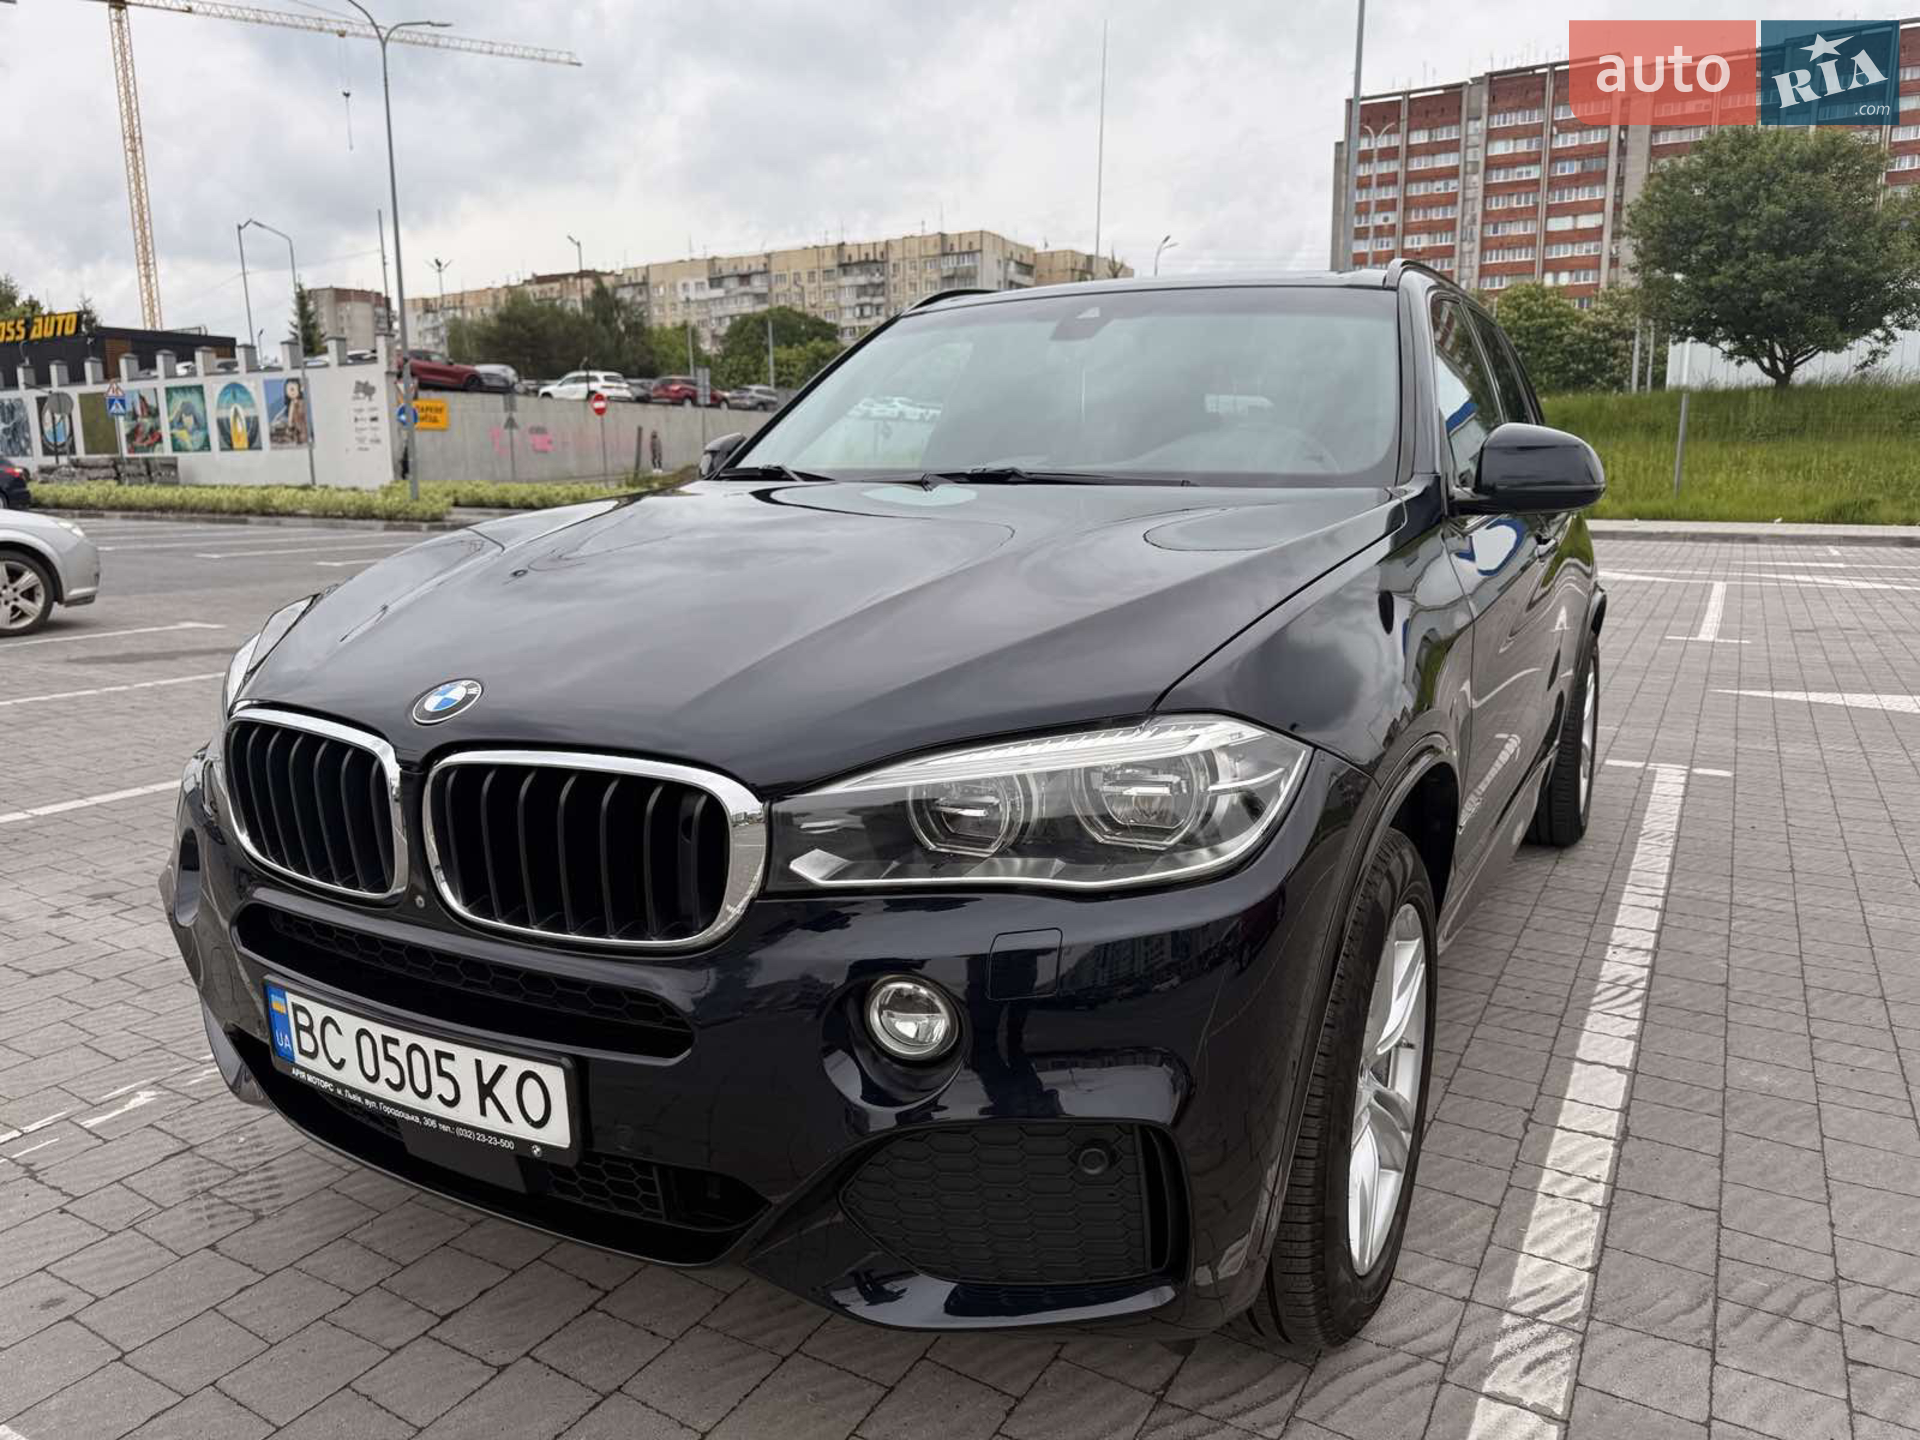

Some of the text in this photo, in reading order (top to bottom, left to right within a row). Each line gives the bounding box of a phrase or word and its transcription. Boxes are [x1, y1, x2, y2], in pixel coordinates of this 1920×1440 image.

[30, 312, 77, 339] AUTO
[275, 1030, 292, 1051] UA
[291, 1001, 552, 1129] BC 0505 KO
[476, 1132, 515, 1150] 23-23-500
